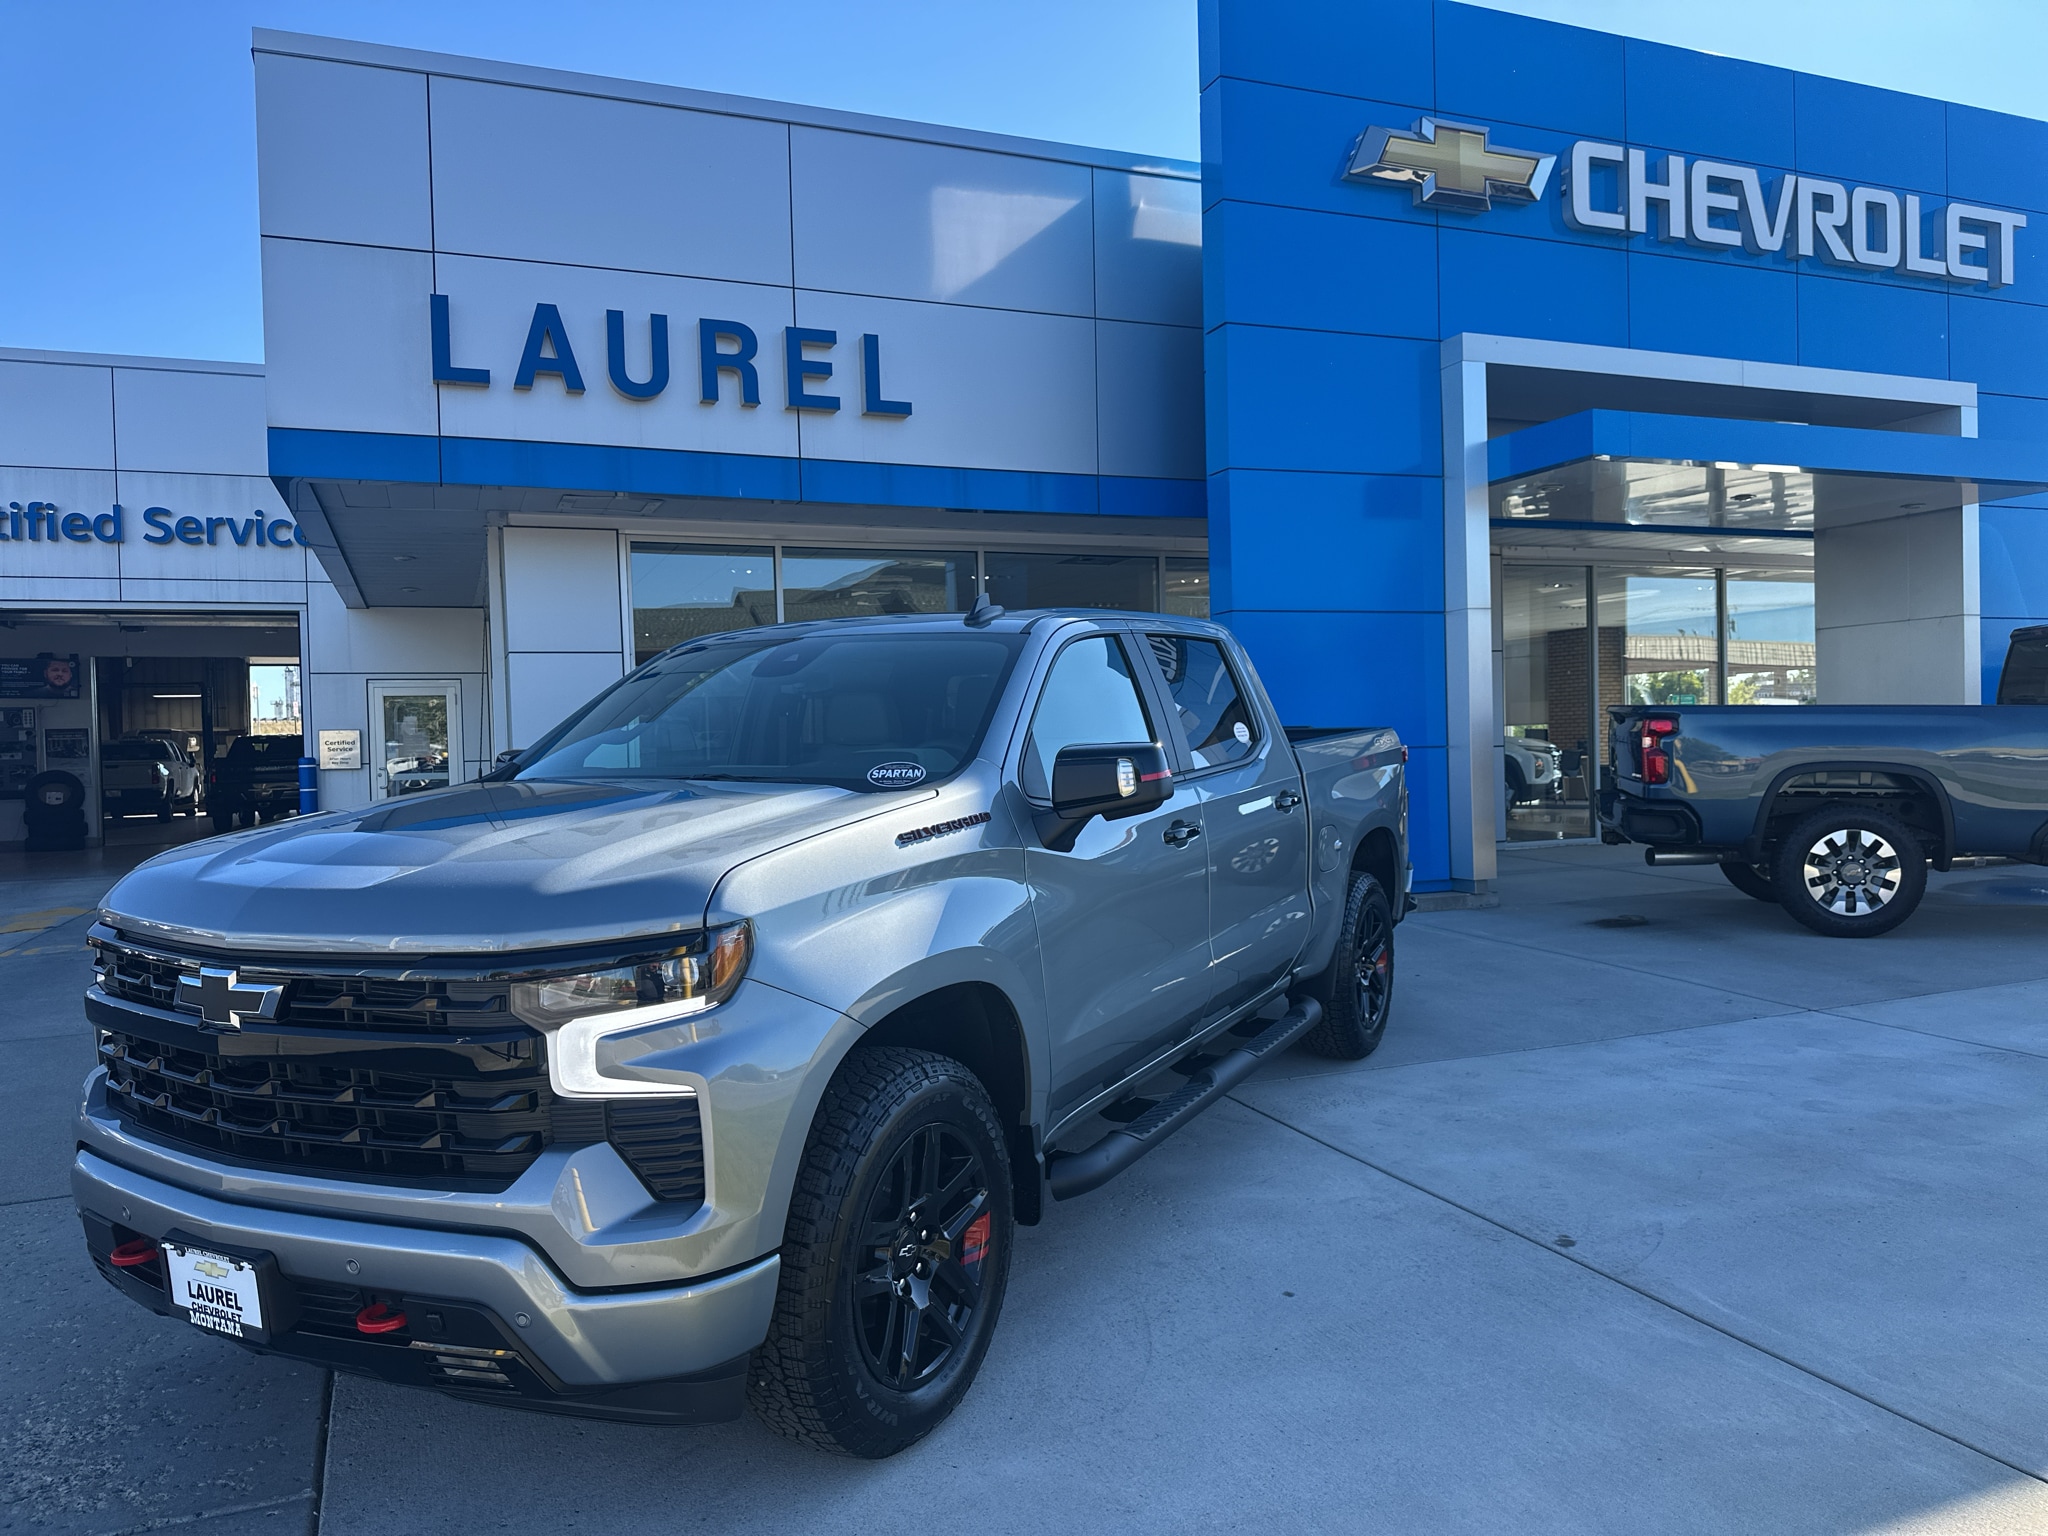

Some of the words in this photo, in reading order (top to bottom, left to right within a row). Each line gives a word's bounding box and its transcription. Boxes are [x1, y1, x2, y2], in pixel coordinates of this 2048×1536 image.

[1565, 140, 2027, 287] CHEVROLET
[430, 294, 912, 418] LAUREL
[871, 769, 922, 779] SPARTAN
[897, 811, 992, 847] SILVERADO
[187, 1280, 243, 1312] LAUREL
[191, 1301, 242, 1323] CHEVROLET
[189, 1310, 243, 1338] MONTANA
